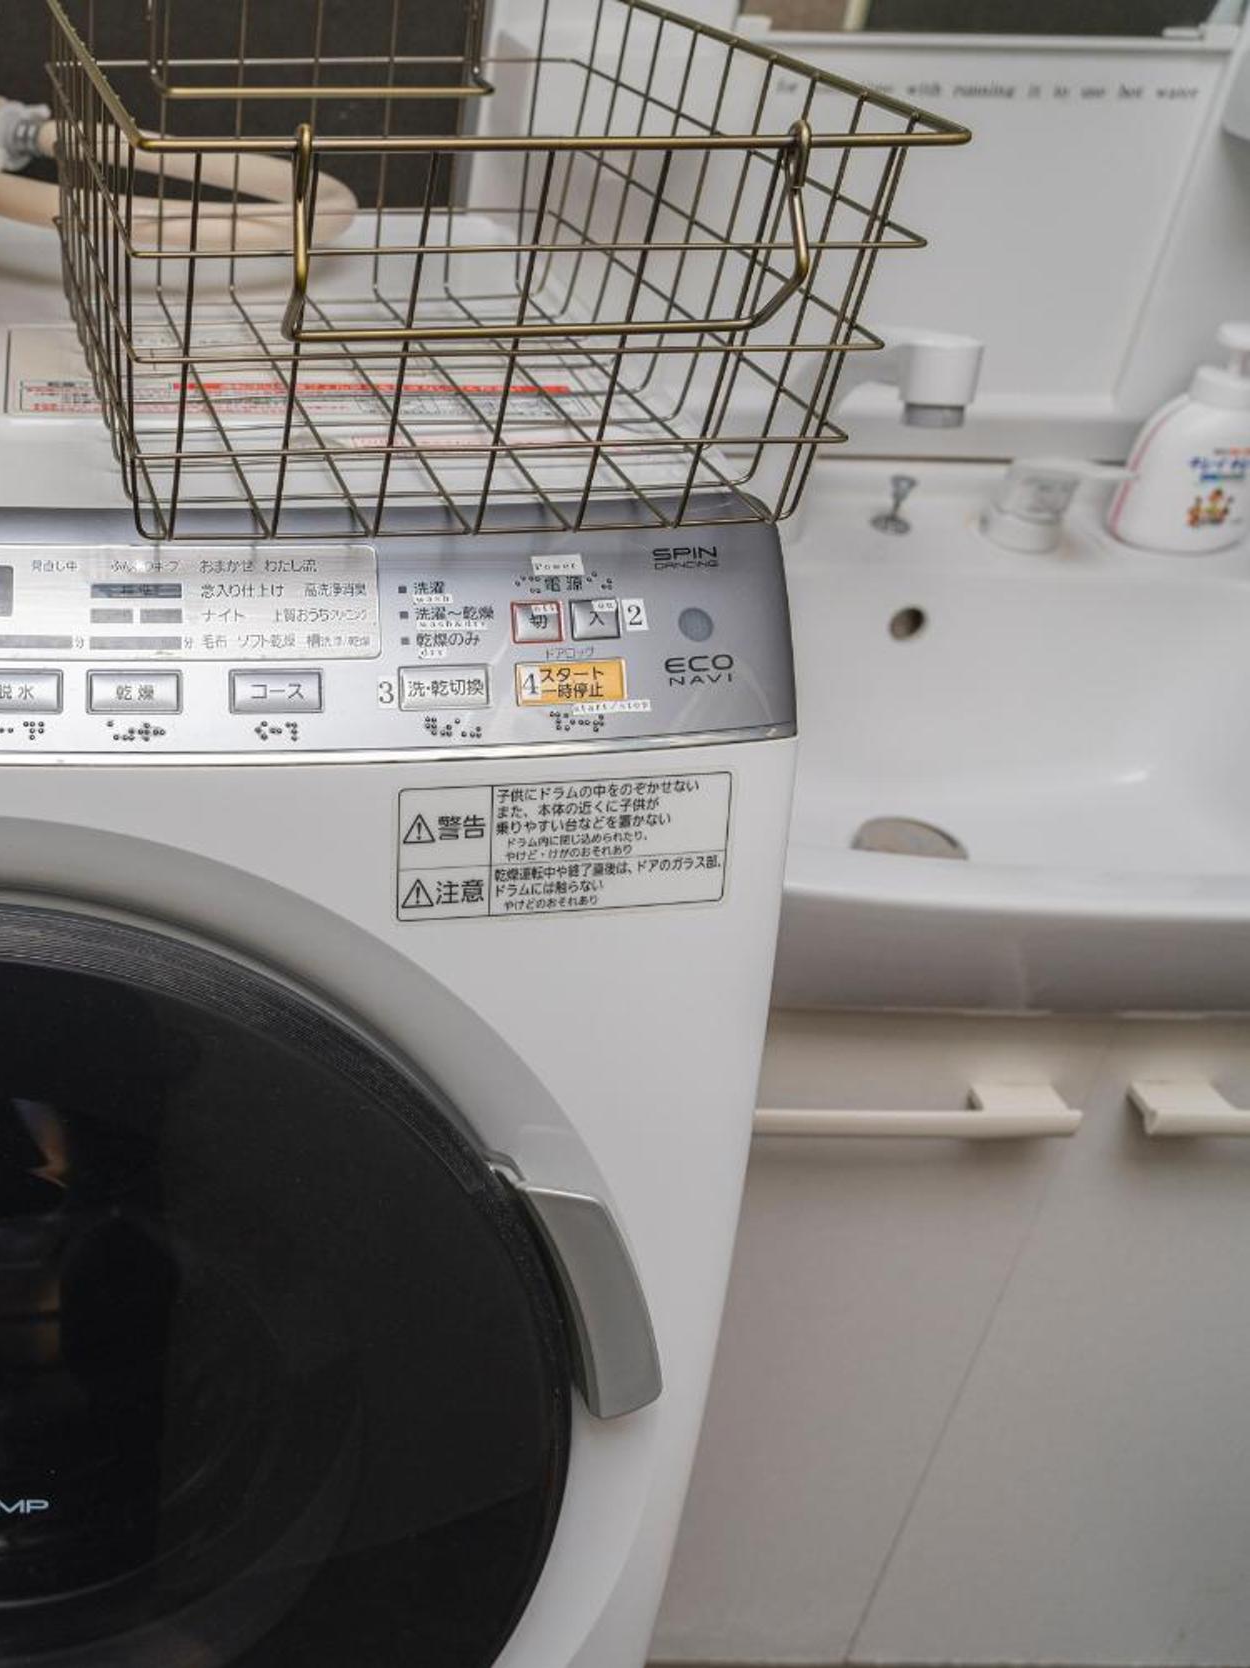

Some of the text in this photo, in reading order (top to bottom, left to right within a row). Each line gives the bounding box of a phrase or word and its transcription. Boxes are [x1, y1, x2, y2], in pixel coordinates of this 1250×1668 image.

[951, 82, 1014, 99] running
[652, 546, 718, 561] SPIN
[200, 559, 254, 573] おまかせ
[200, 583, 284, 598] 念入り仕上げ
[413, 581, 445, 595] 洗濯
[545, 575, 583, 592] 電源
[202, 608, 246, 622] ナイト
[589, 611, 605, 626] 入
[627, 604, 643, 626] 2
[416, 632, 480, 647] 乾燥のみ
[664, 654, 734, 674] ECO
[540, 666, 605, 683] スタート
[669, 673, 733, 687] NAVI
[116, 685, 155, 701] 乾燥
[250, 683, 305, 700] コース
[379, 681, 394, 704] 3
[523, 673, 540, 696] 4
[496, 780, 701, 804] 子供にドラムの中をのぞかせない
[437, 814, 486, 841] 警告
[495, 812, 672, 836] 乗りやすい台などを置かない
[436, 878, 485, 906] 注意
[495, 880, 604, 899] ドラムには触らない
